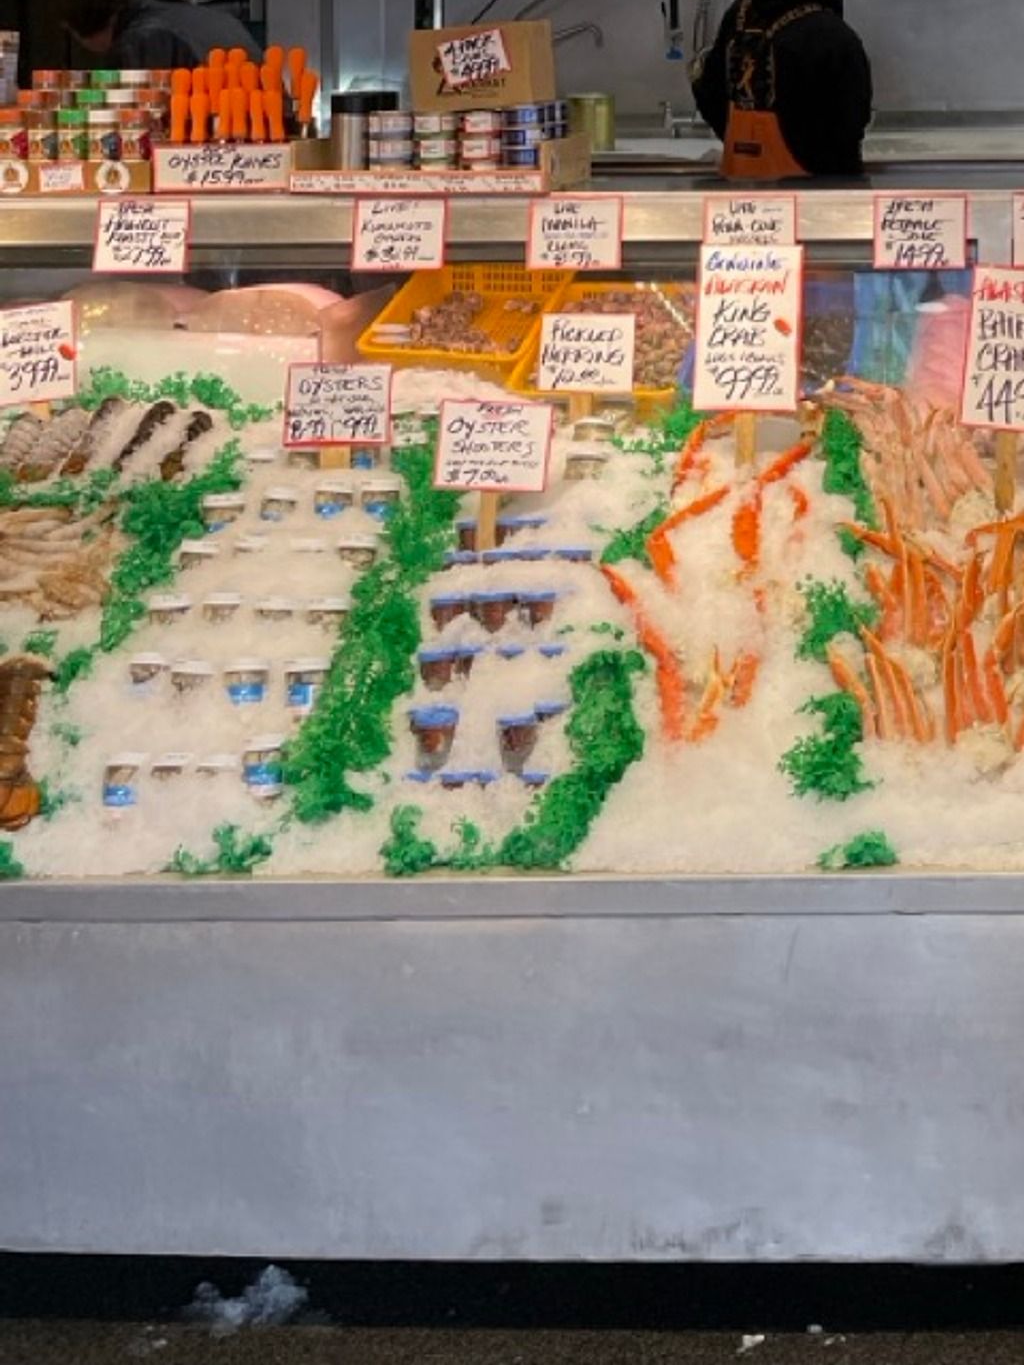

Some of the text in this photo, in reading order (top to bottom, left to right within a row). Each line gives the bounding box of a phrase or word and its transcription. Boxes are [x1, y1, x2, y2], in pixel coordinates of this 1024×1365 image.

[712, 295, 771, 327] KING
[298, 376, 384, 395] OYSTERS
[447, 418, 530, 439] OYSTER
